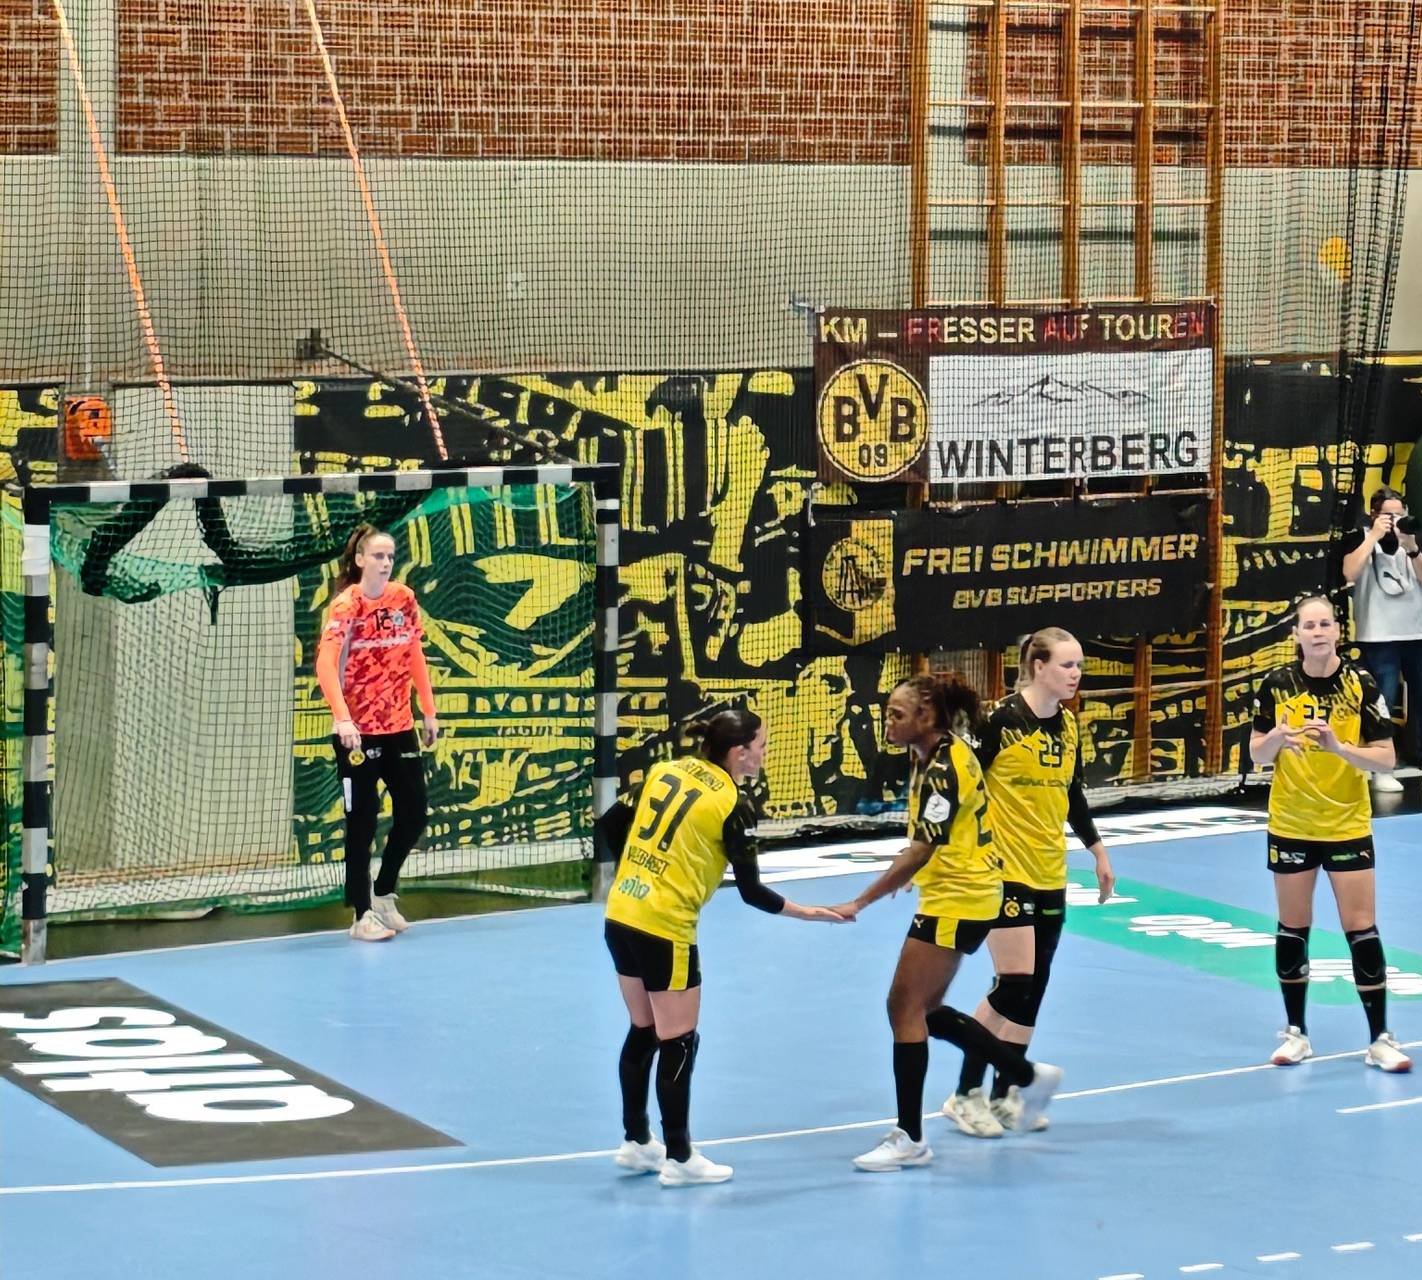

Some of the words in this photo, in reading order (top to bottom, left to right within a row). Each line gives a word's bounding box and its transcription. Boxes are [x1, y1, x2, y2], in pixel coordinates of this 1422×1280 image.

[819, 316, 868, 343] KM
[907, 316, 1036, 345] FRESSER
[1043, 313, 1092, 342] AUF
[1097, 311, 1205, 341] TOUREN
[835, 373, 917, 443] BVB
[858, 444, 888, 468] 09
[936, 430, 1199, 479] WINTERBERG
[952, 587, 1003, 610] BVB
[1006, 577, 1163, 606] SUPPORTERS
[637, 772, 704, 853] 31
[0, 1006, 355, 1123] atlas
